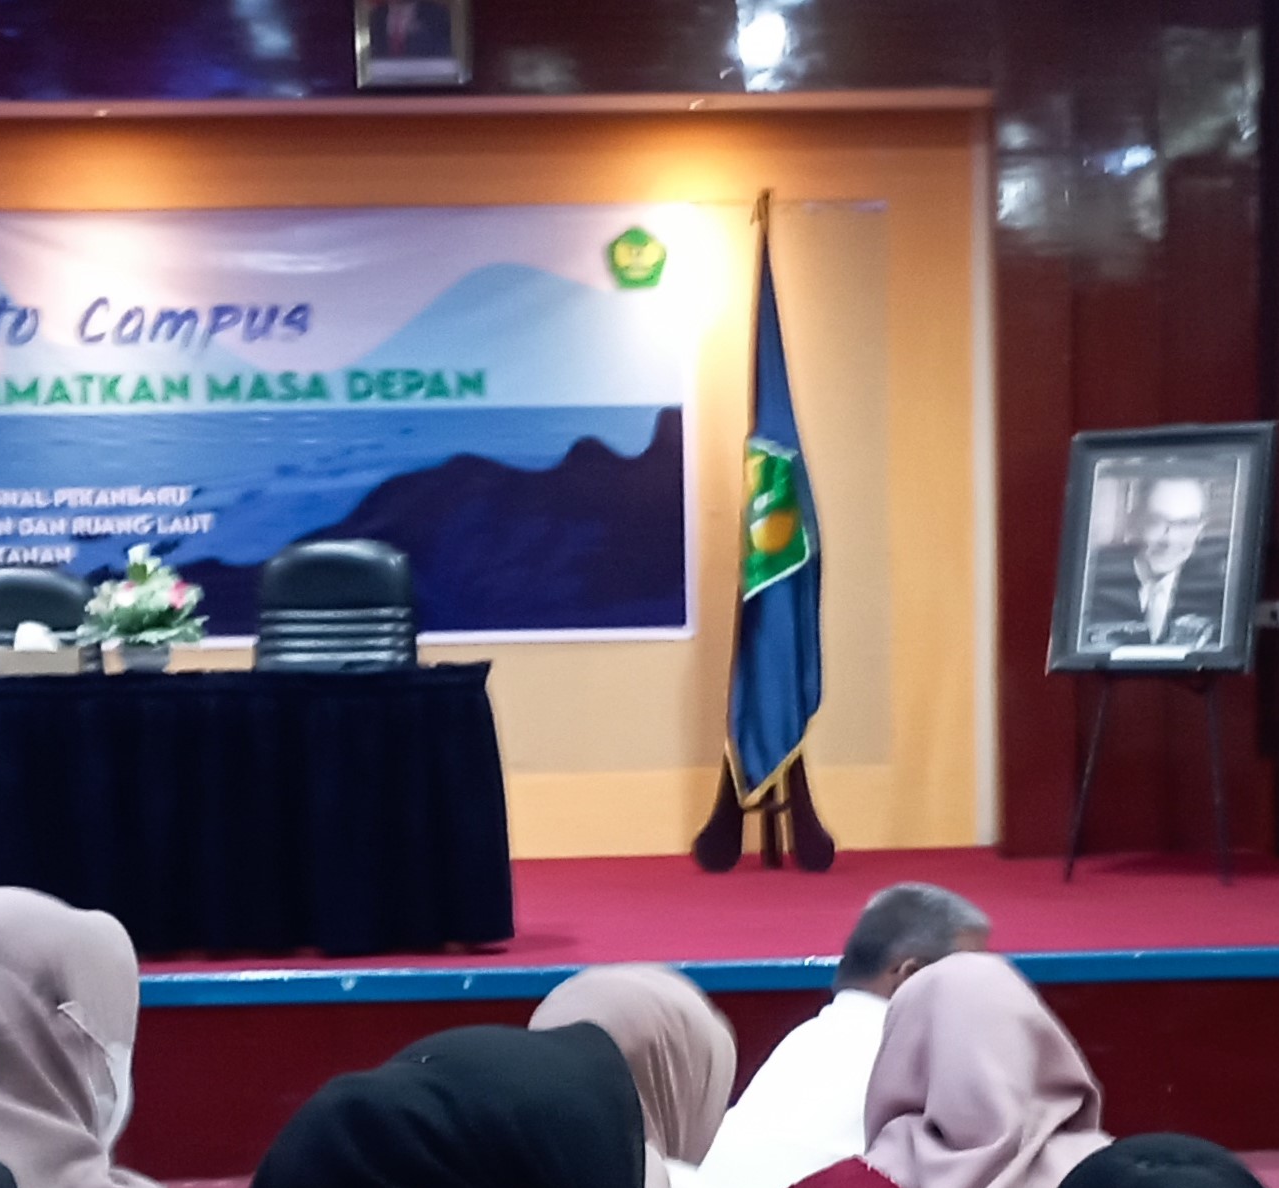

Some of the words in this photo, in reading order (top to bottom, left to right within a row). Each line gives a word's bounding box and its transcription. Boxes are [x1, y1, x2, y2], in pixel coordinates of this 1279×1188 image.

[78, 296, 314, 352] Campus
[207, 371, 328, 402] MASA
[347, 369, 486, 401] DEPAN
[54, 485, 193, 507] PEKANBARU
[18, 517, 67, 537] DAN
[72, 514, 155, 535] RUANG
[157, 513, 215, 534] LAUT
